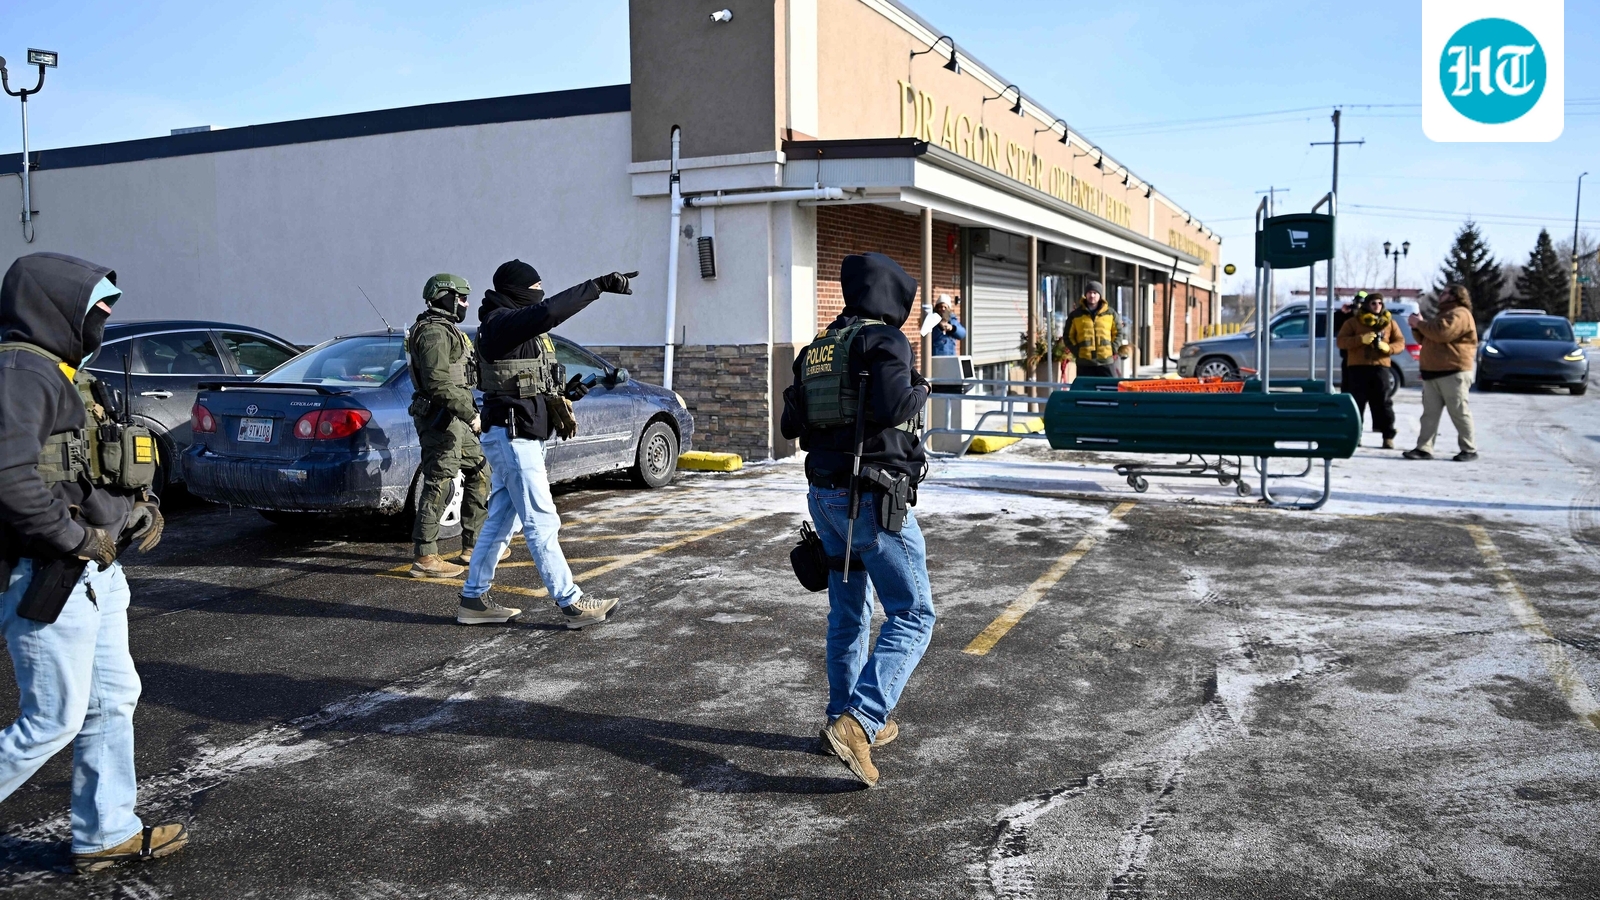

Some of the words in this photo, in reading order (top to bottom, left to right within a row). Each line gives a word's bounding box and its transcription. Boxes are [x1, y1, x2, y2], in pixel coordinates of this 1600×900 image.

[897, 79, 1000, 172] DRAGON
[1006, 138, 1045, 192] STAR
[806, 345, 834, 365] POLICE
